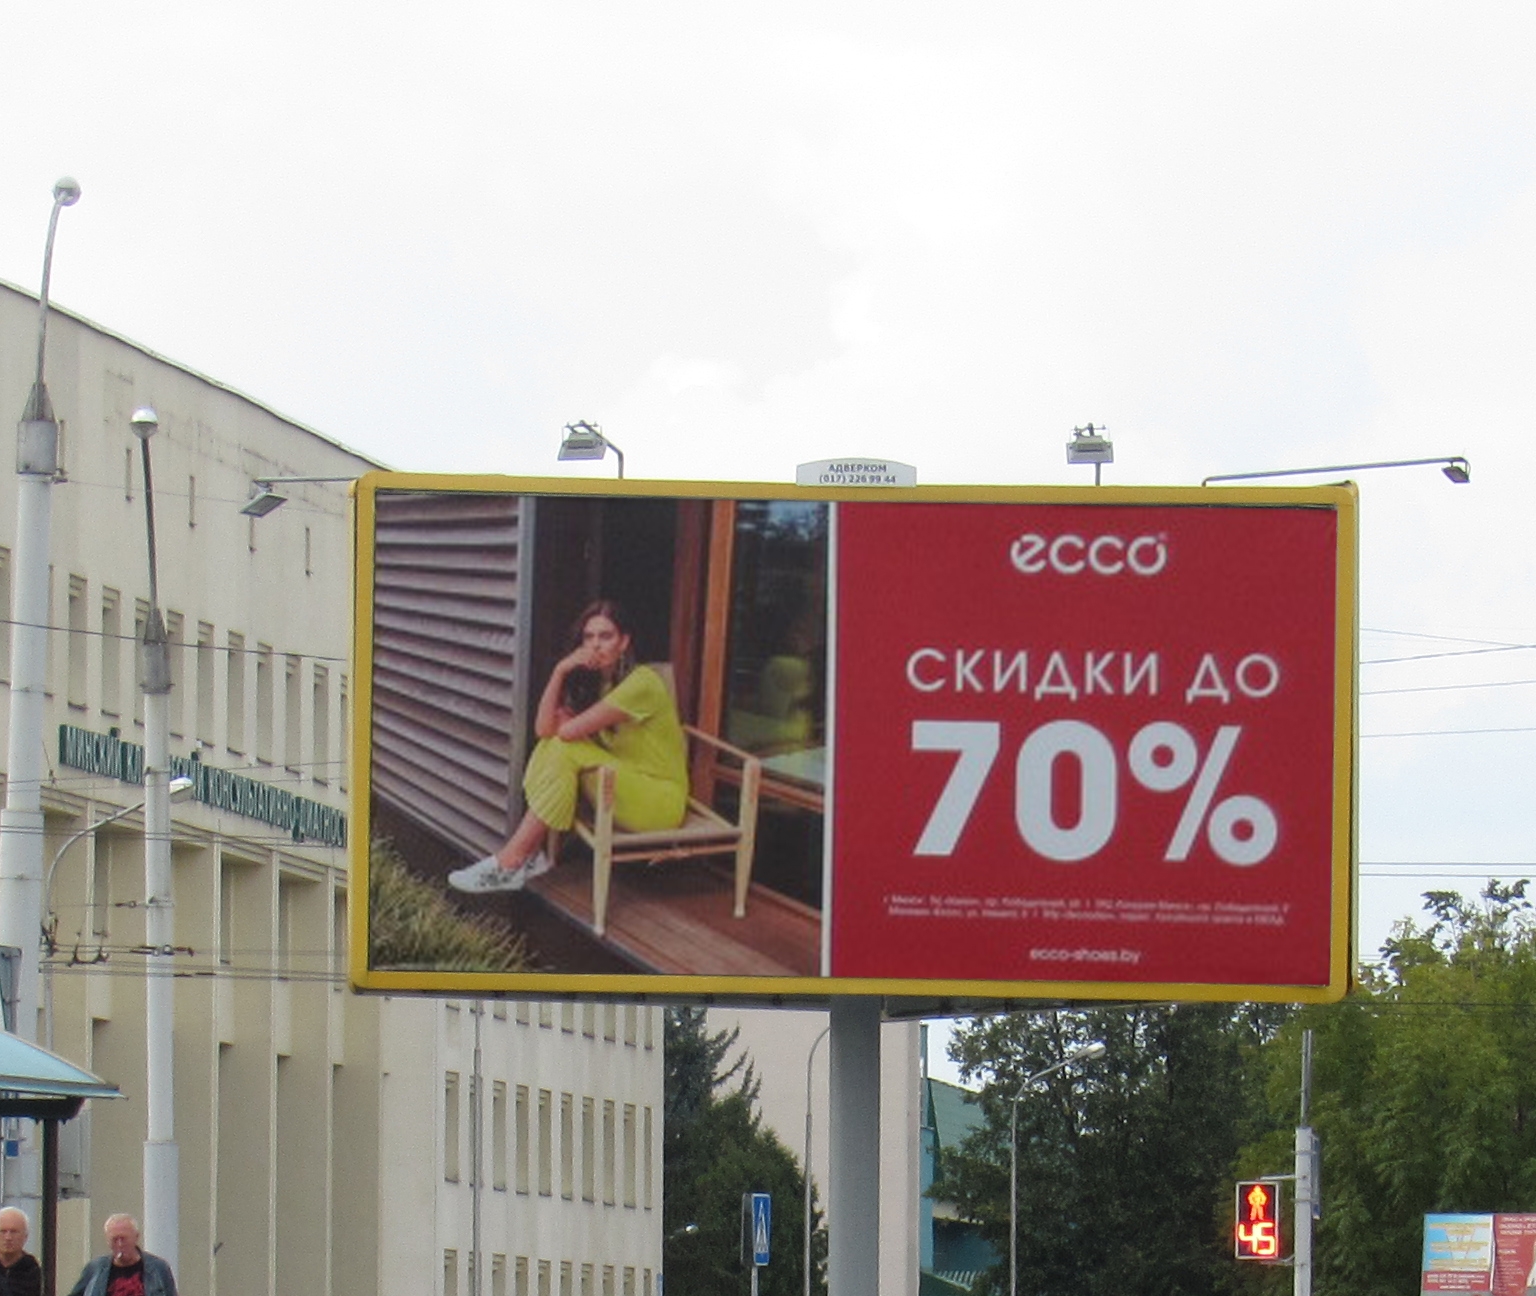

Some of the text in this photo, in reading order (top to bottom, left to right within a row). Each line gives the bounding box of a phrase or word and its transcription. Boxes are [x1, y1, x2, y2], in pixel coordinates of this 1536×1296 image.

[819, 475, 896, 484] (017) 226 99 44
[828, 464, 887, 473] АДВЕРКОМ
[1010, 534, 1167, 575] ecco
[906, 648, 1281, 704] СКИДКИ ДО
[66, 726, 122, 779] МИНСКИЙ
[910, 719, 1279, 866] 70%
[1030, 948, 1142, 965] ecco-shoes.by
[1238, 1221, 1276, 1255] 45
